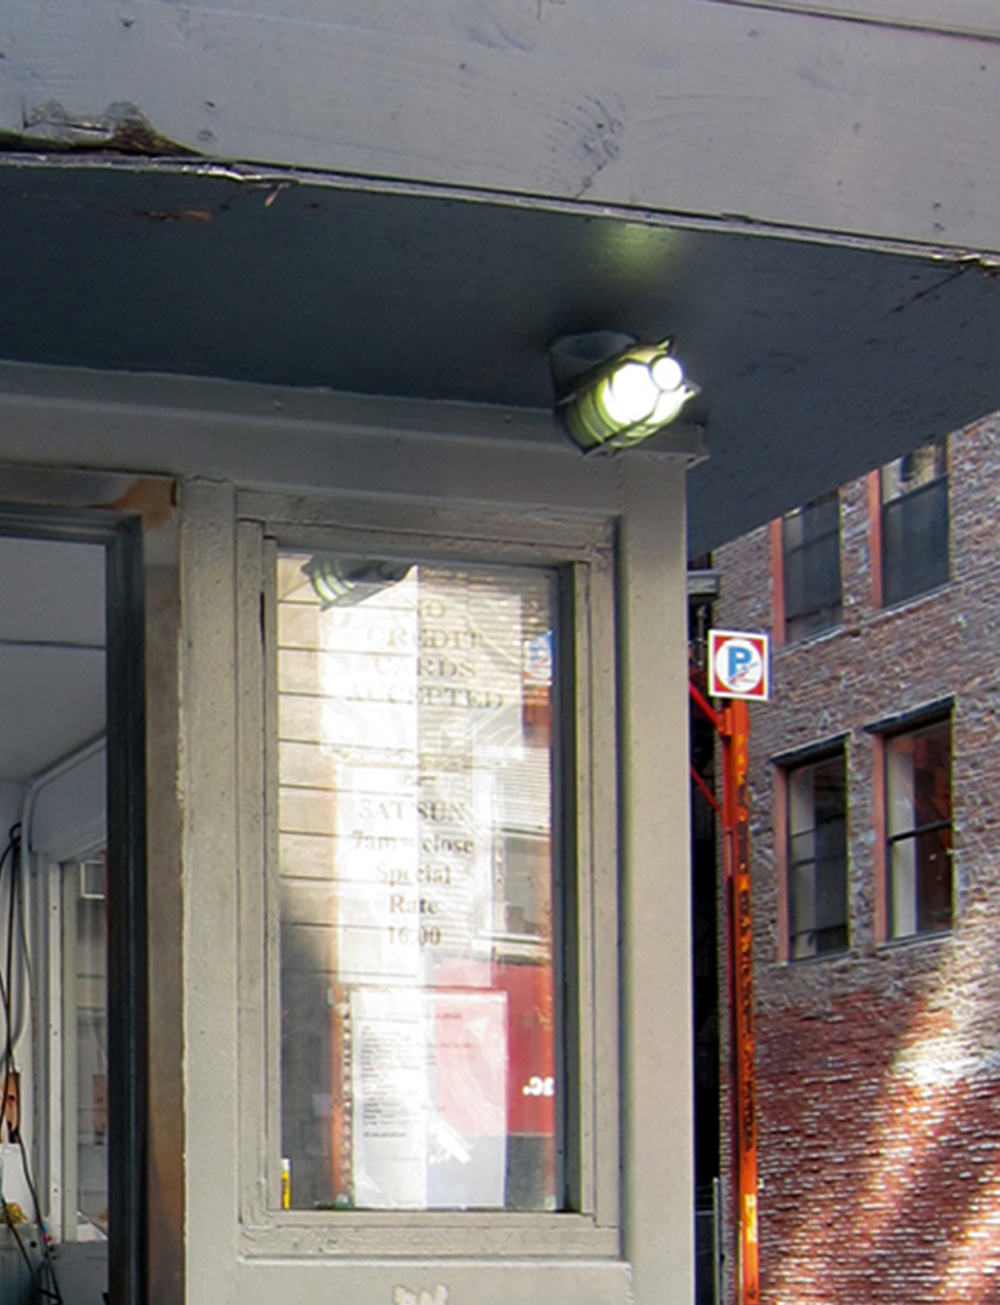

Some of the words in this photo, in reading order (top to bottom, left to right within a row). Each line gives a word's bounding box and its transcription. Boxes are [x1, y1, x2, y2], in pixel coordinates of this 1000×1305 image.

[422, 833, 474, 853] close
[376, 862, 451, 886] Special
[389, 894, 439, 914] Rate
